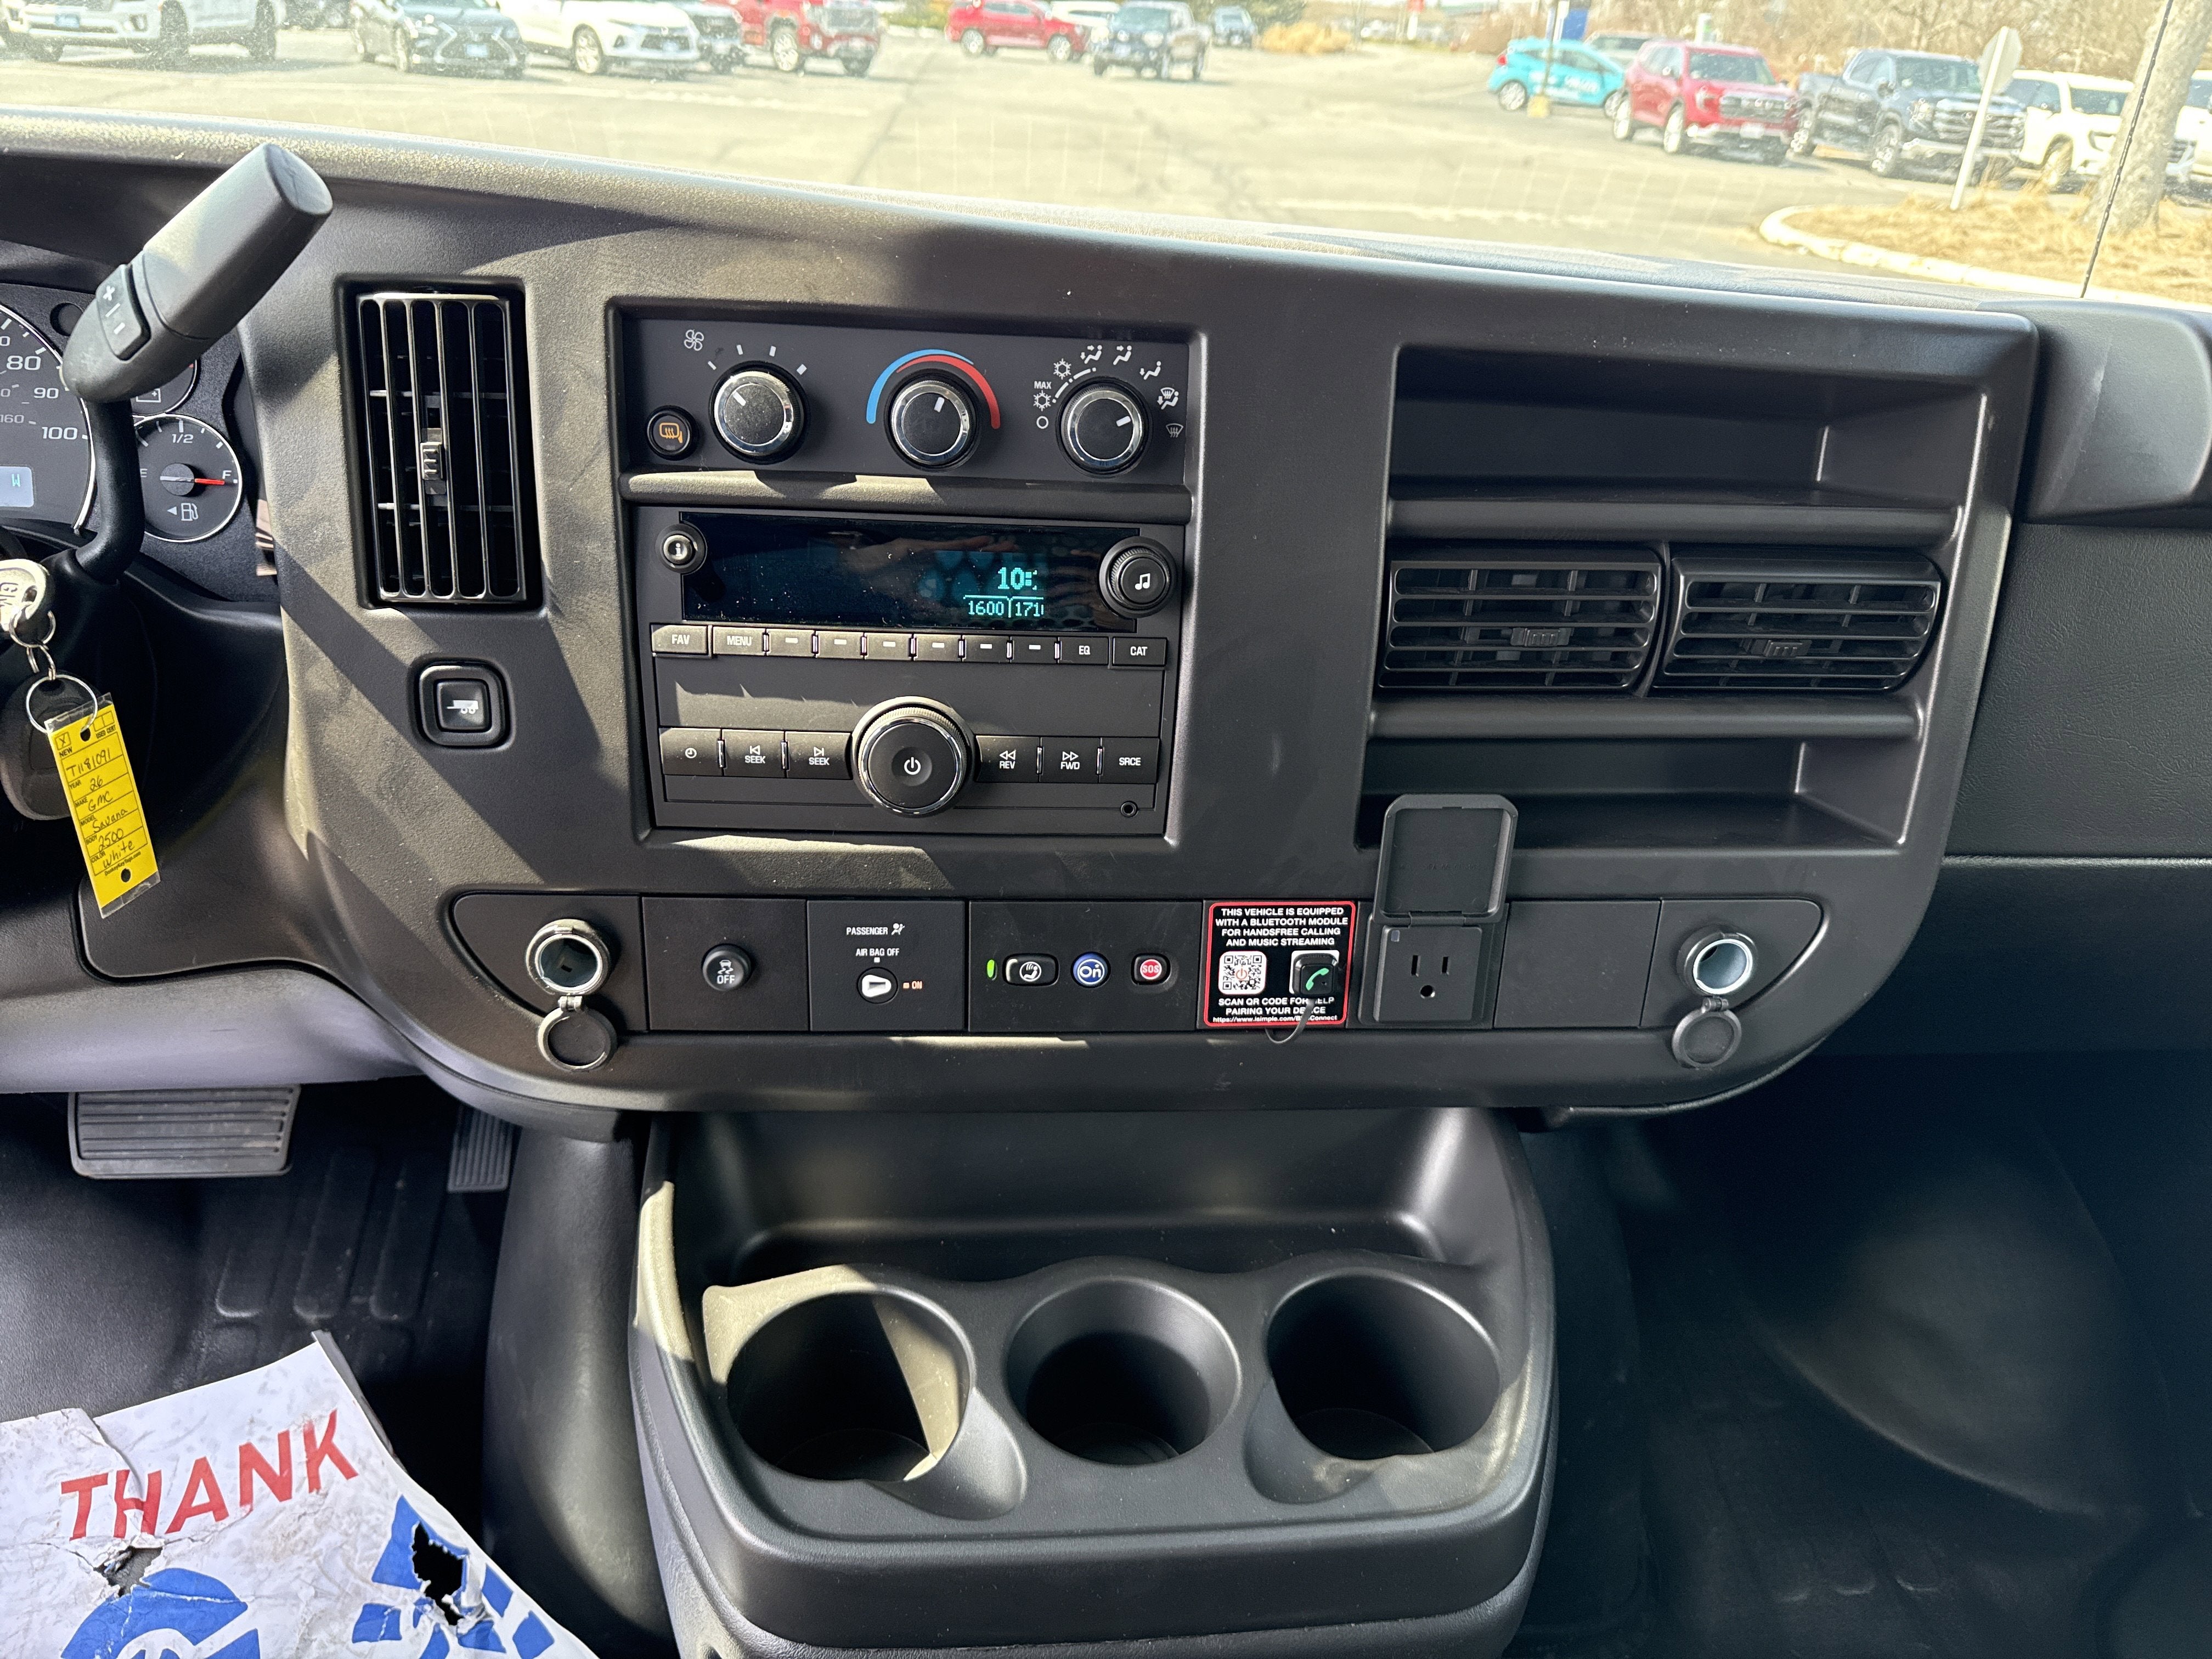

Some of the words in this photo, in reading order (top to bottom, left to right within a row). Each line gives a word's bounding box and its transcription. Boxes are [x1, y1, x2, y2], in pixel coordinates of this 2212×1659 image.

[6, 356, 41, 370] 80
[1034, 381, 1052, 389] MAX
[33, 387, 59, 399] 90
[0, 414, 25, 424] 160
[42, 427, 78, 440] 100
[172, 434, 194, 443] 1/2
[140, 469, 148, 478] E
[222, 470, 232, 479] F
[11, 473, 21, 487] W
[968, 600, 1004, 616] 1600
[672, 634, 690, 645] FAV
[726, 635, 752, 646] MENU
[1079, 645, 1091, 655] EQ
[1130, 646, 1148, 656] CAT
[59, 746, 73, 758] NEW
[744, 755, 766, 764] SEEK
[809, 757, 830, 765] SEEK
[1119, 757, 1141, 766] SRCE
[999, 761, 1015, 769] REV
[1060, 761, 1080, 770] FWD
[69, 780, 82, 790] YEAR
[89, 775, 103, 791] 26
[75, 797, 88, 808] MAKE
[88, 791, 113, 812] GMC
[80, 815, 97, 826] MODEL
[92, 808, 128, 833] Savana
[85, 835, 98, 845] BODY
[98, 828, 124, 853] 2500
[91, 851, 106, 864] COLOR
[1221, 908, 1242, 916] THIS
[1244, 907, 1284, 916] VEHICLE
[1285, 907, 1294, 916] IS
[1296, 907, 1344, 916] EQUIPPED
[1250, 918, 1306, 926] BLUETOOTH
[1308, 917, 1348, 926] MODULE
[846, 927, 888, 935] PASSENGER
[1221, 928, 1241, 936] FOR
[1243, 928, 1299, 936] HANDSFREE
[1301, 927, 1341, 936] CALLING
[1226, 938, 1246, 947] AND
[1248, 938, 1279, 946] MUSIC
[1280, 938, 1335, 946] STREAMING
[855, 948, 867, 956] AIR
[869, 948, 884, 956] BAG
[887, 948, 900, 956] OFF
[1079, 964, 1102, 978] On
[1142, 964, 1159, 974] SOS
[717, 974, 735, 984] OFF
[911, 980, 922, 989] ON
[1218, 998, 1244, 1006] SCAN
[1245, 998, 1260, 1006] QR
[1262, 997, 1288, 1006] CODE
[1226, 1007, 1262, 1015] PAIRING
[1265, 1007, 1291, 1015] YOUR
[1293, 1006, 1326, 1014] DECE
[60, 1409, 359, 1542] THANK
